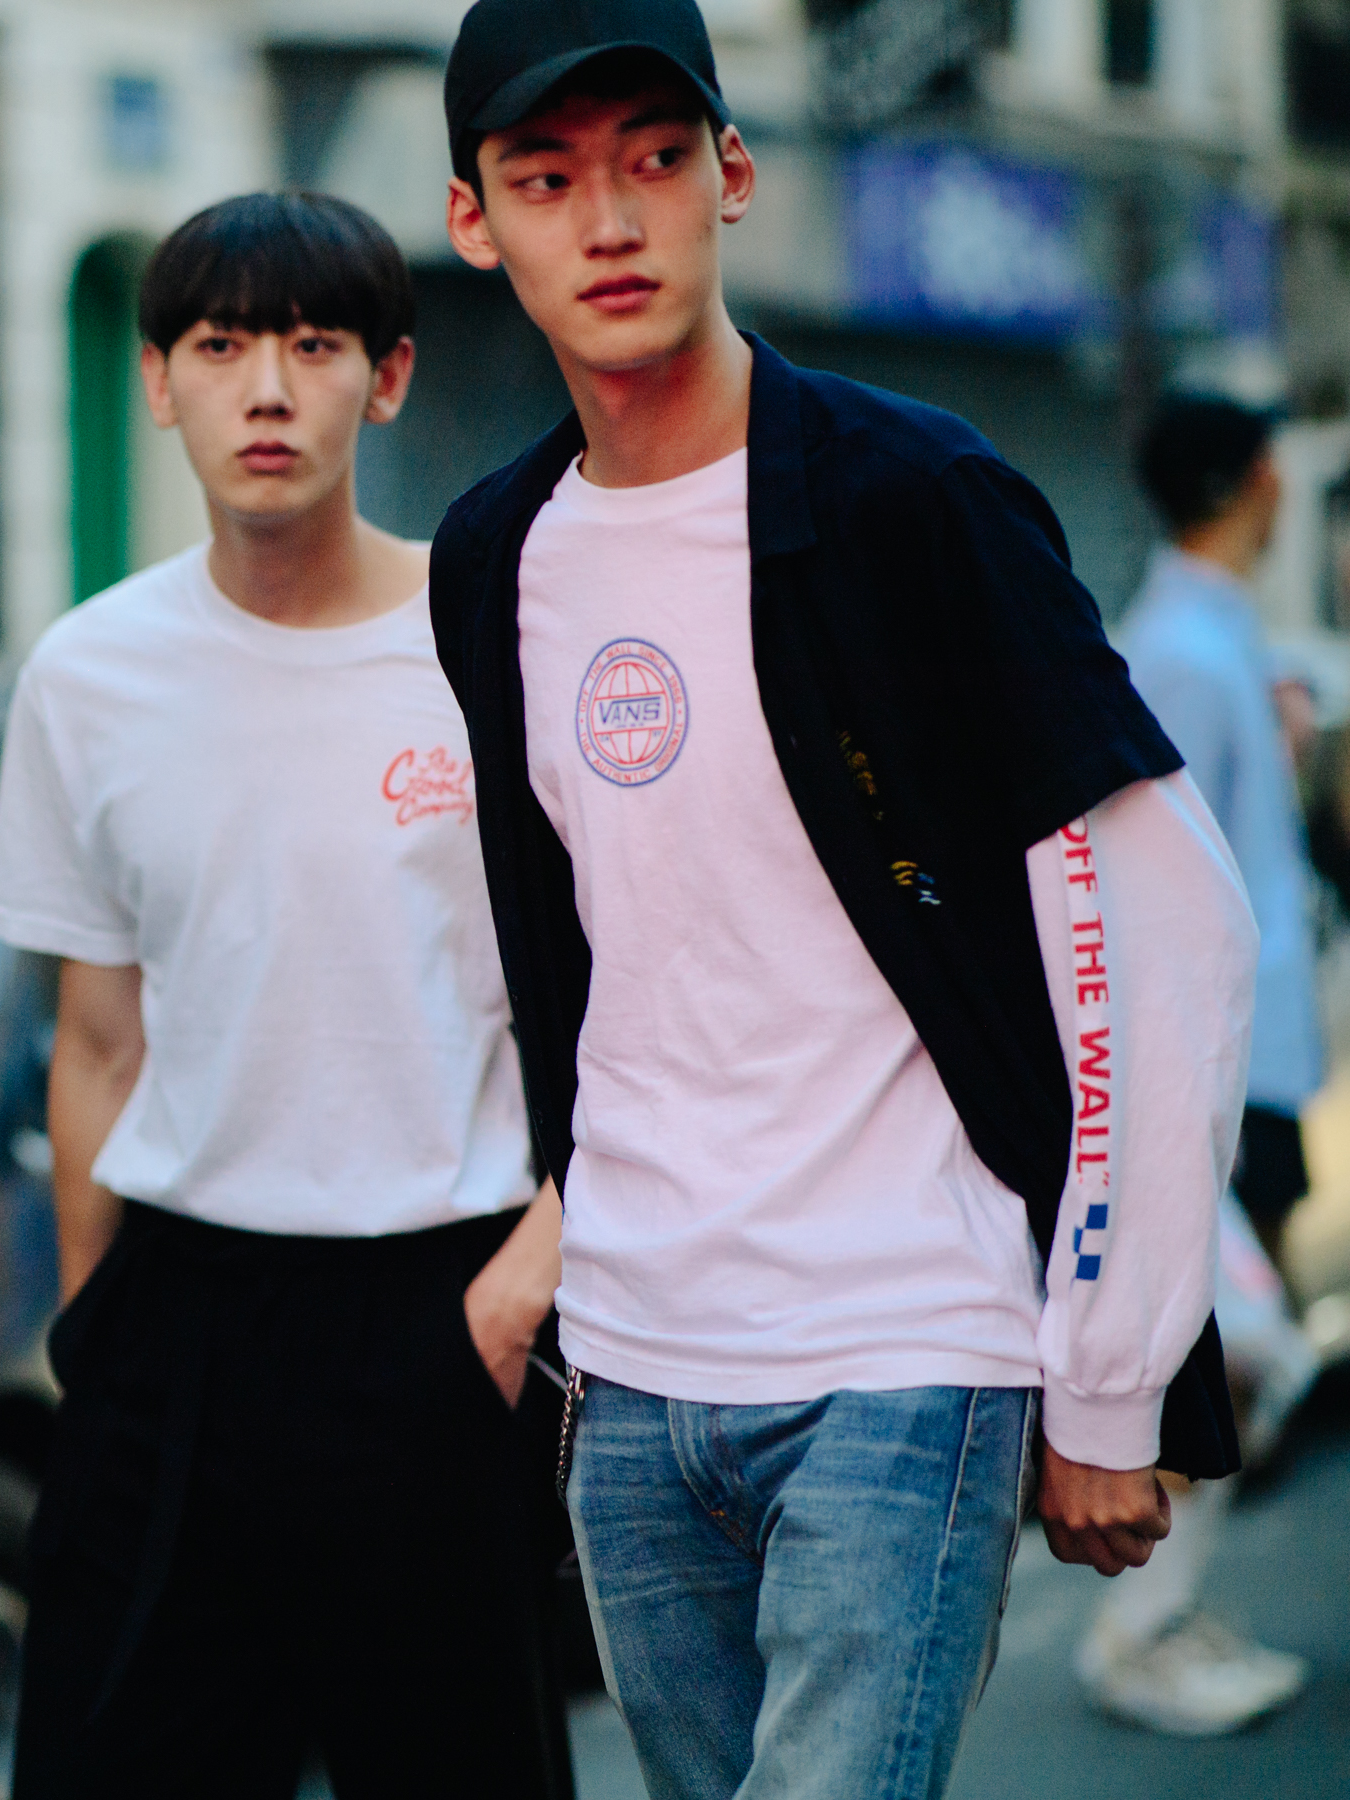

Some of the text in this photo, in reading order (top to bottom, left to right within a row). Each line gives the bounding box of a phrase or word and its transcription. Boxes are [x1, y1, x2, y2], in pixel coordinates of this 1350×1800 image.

[580, 687, 589, 712] OFF
[589, 658, 603, 680] THE
[605, 645, 632, 659] WALL
[599, 697, 661, 724] VANS
[580, 731, 592, 755] THE
[592, 758, 651, 782] AUTHENTIC
[1072, 911, 1109, 1005] THE
